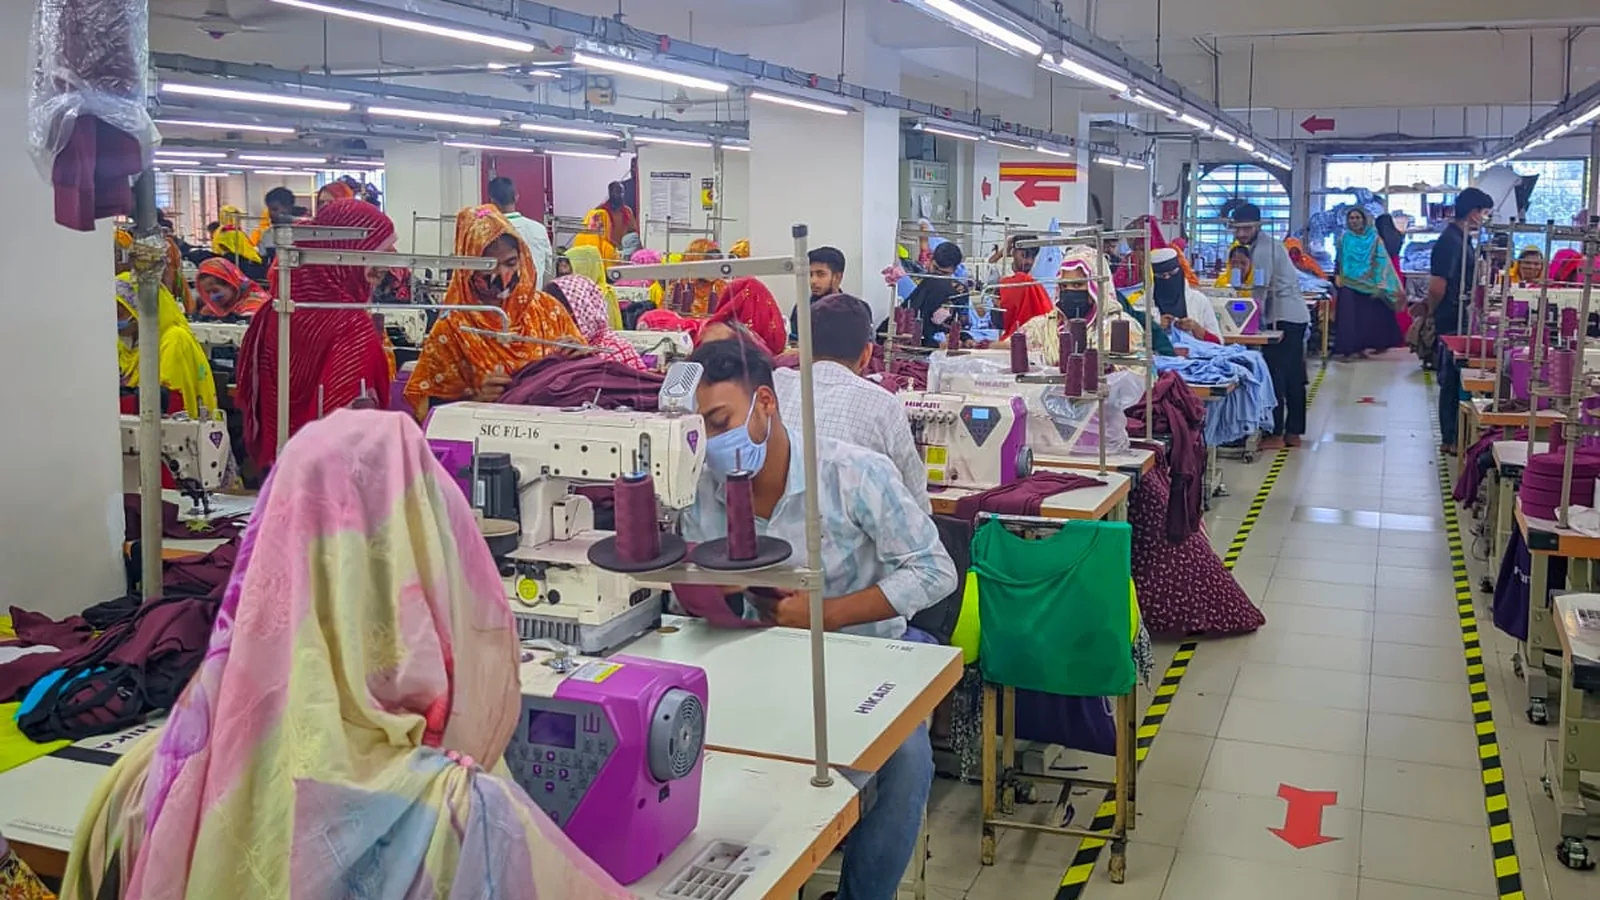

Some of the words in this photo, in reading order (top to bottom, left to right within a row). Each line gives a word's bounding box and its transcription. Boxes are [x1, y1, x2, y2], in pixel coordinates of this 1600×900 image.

[904, 401, 940, 409] HIKARI
[480, 424, 500, 437] SIC
[504, 426, 540, 439] F/L-16
[853, 683, 897, 714] HIKARI
[95, 725, 158, 749] HIKA
